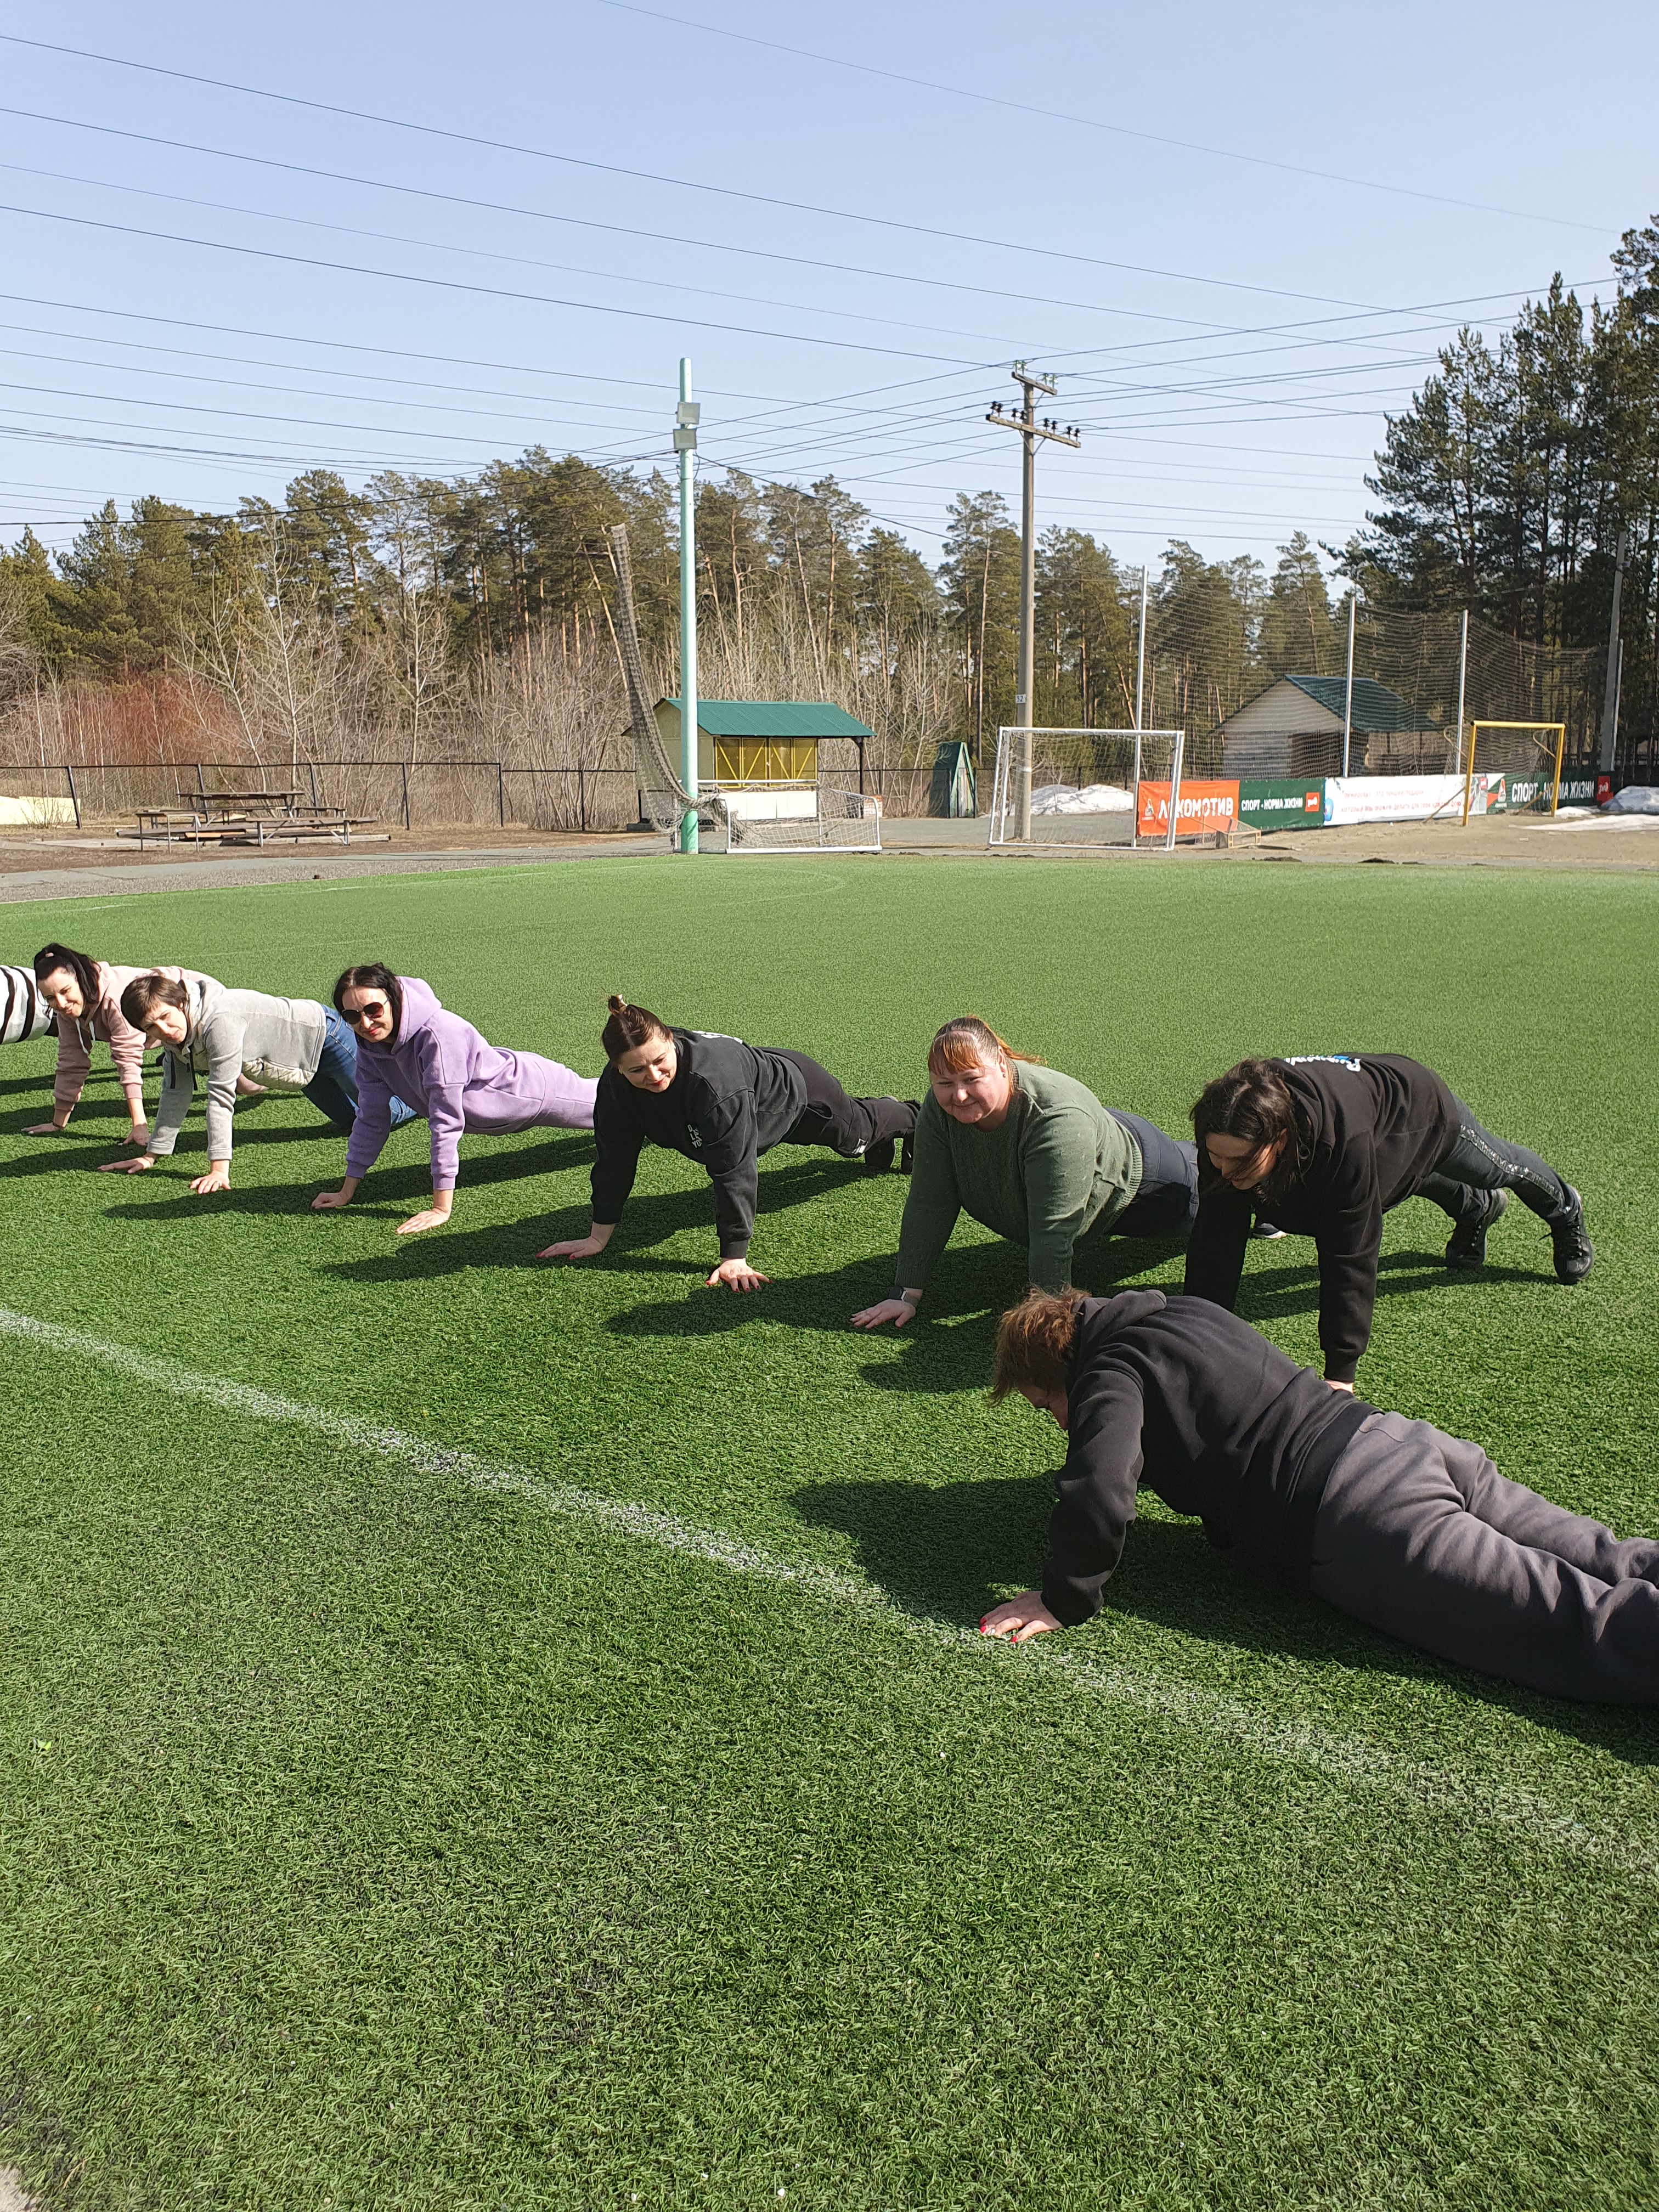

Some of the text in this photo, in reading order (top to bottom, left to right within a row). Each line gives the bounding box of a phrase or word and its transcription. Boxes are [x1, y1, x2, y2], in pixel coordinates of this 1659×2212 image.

[1511, 782, 1538, 803] СПОРТ
[1543, 781, 1568, 801] НОМА
[1570, 780, 1594, 799] ЖИЗНИ
[1158, 797, 1233, 819] ЛКОМОТИВ
[1242, 799, 1260, 811] СПОРТ
[1263, 798, 1283, 810] НОРМА
[1284, 797, 1303, 809] ЖИЗНИ
